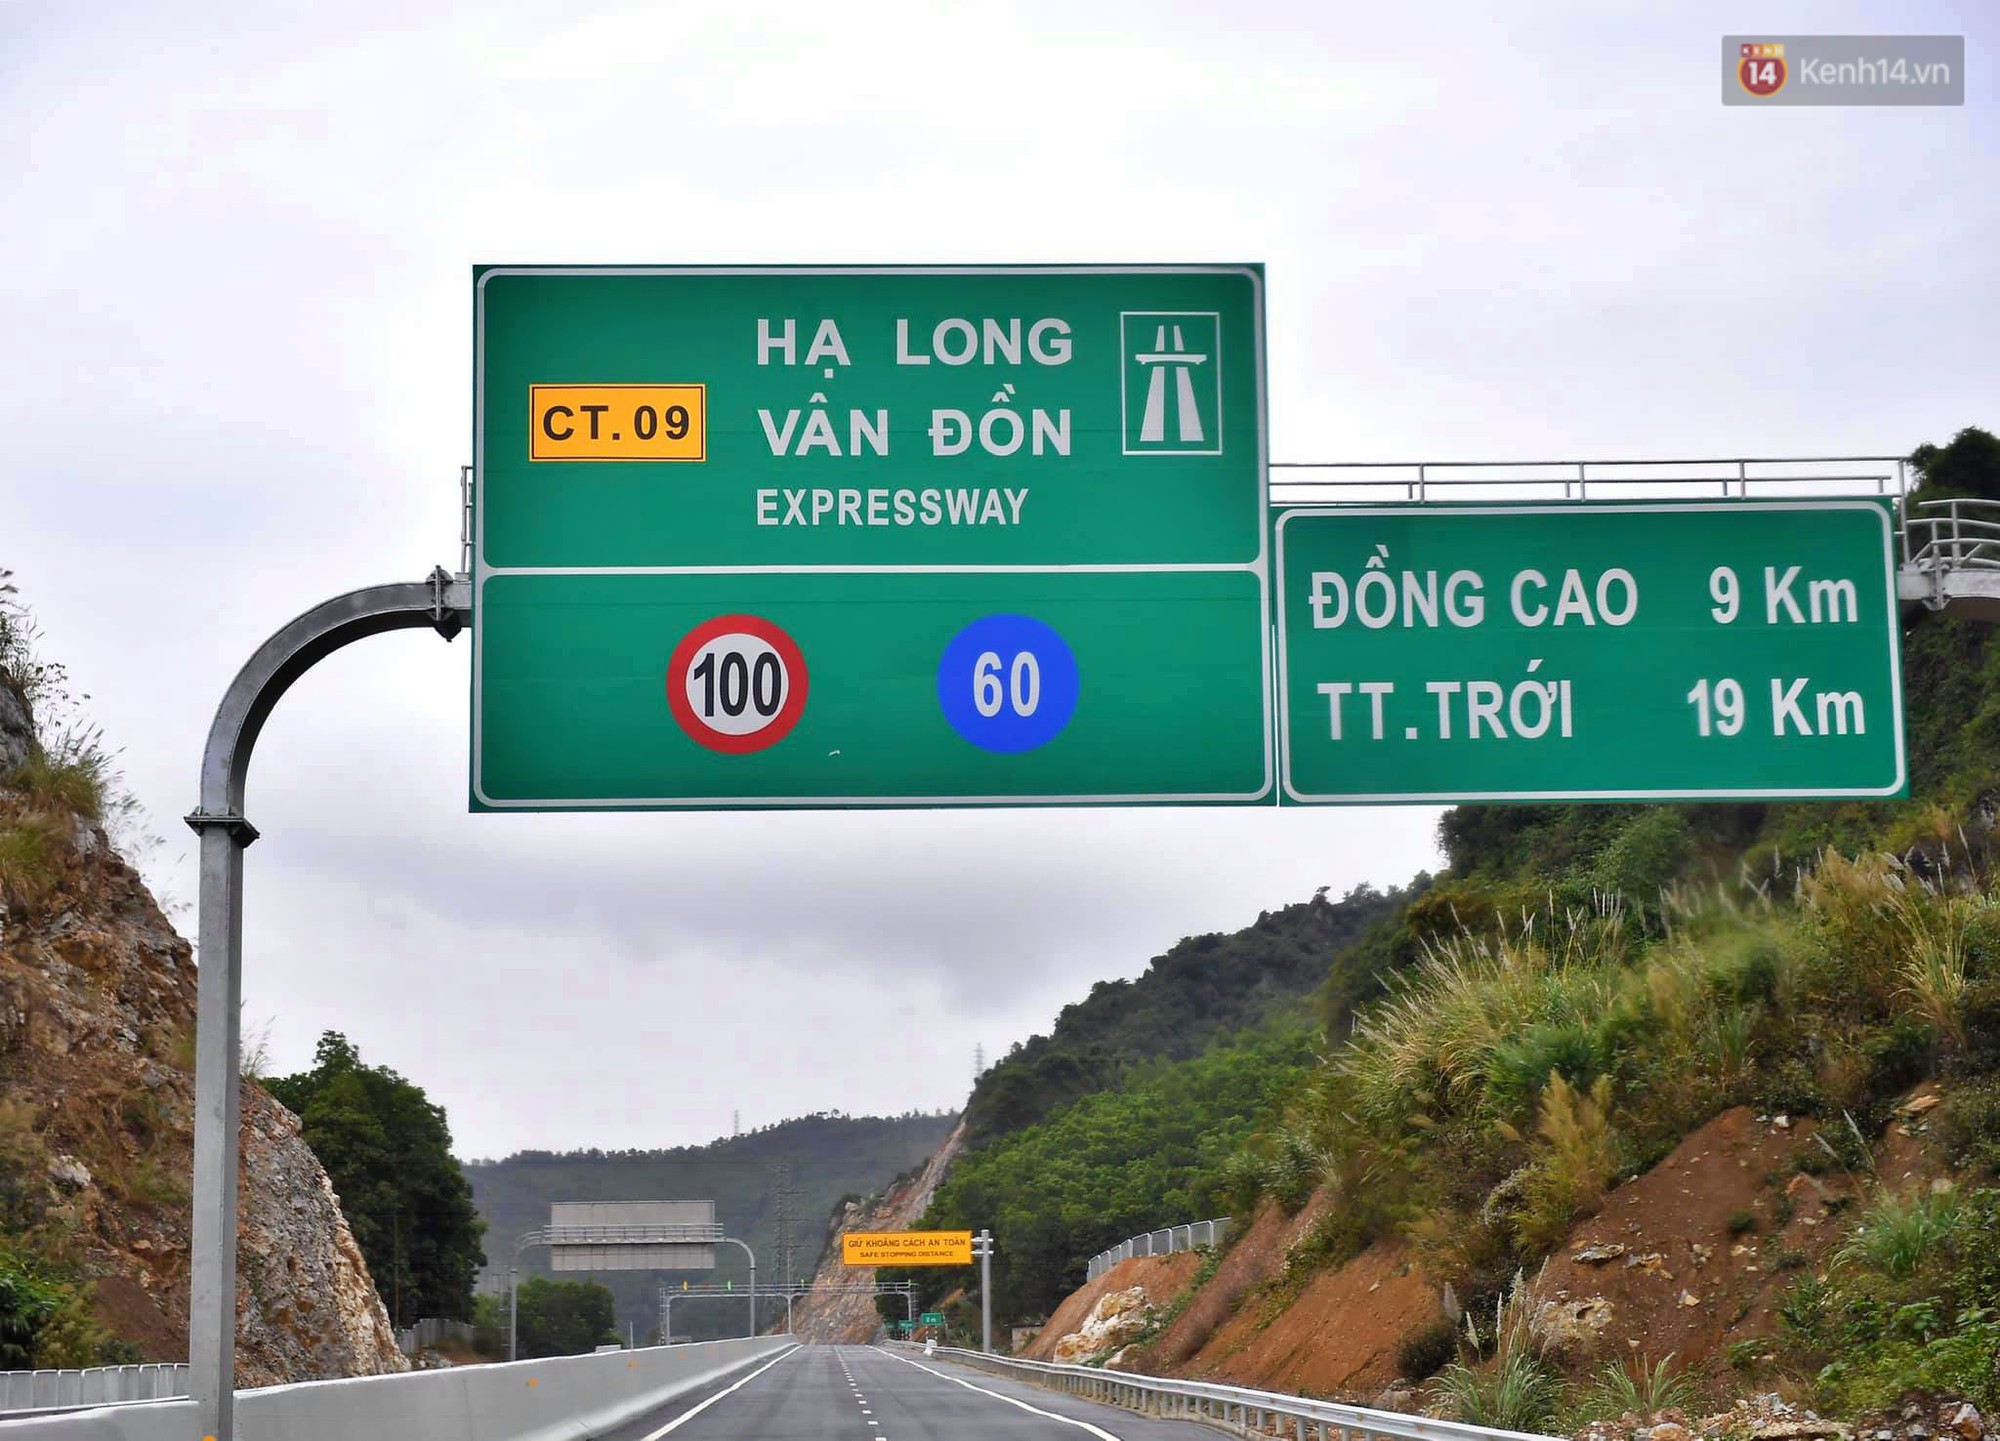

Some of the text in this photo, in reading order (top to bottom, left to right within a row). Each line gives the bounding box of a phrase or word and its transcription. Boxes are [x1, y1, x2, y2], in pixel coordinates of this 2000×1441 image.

[757, 317, 1073, 379] HẠ LONG
[758, 383, 1071, 456] VÂN ĐỒN
[756, 487, 1029, 526] EXPRESSWAY
[1309, 544, 1858, 629] ĐỒNG CAO 9 Km
[693, 651, 782, 718] 100
[973, 651, 1040, 718] 60
[1687, 678, 1745, 738] 19
[1770, 677, 1865, 736] Km
